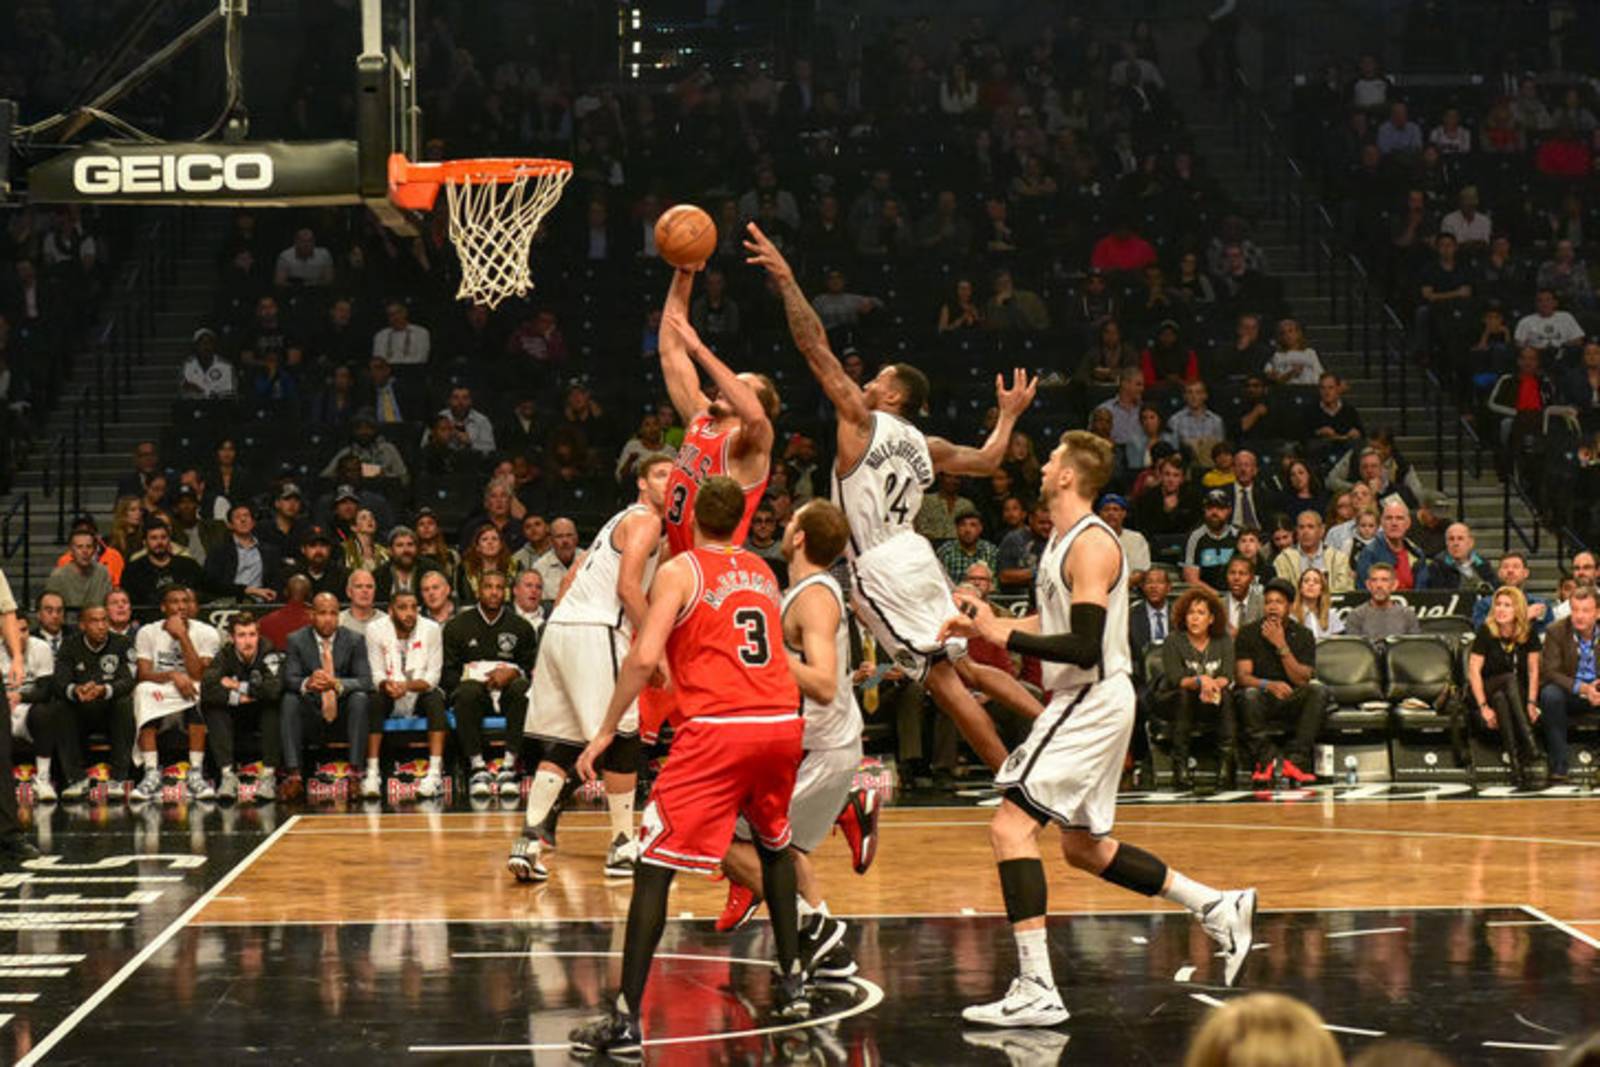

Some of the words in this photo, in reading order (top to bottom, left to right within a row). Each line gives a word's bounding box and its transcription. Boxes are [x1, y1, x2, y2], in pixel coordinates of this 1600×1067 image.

[73, 153, 274, 194] GEICO
[884, 472, 912, 525] 24
[733, 606, 772, 668] 3
